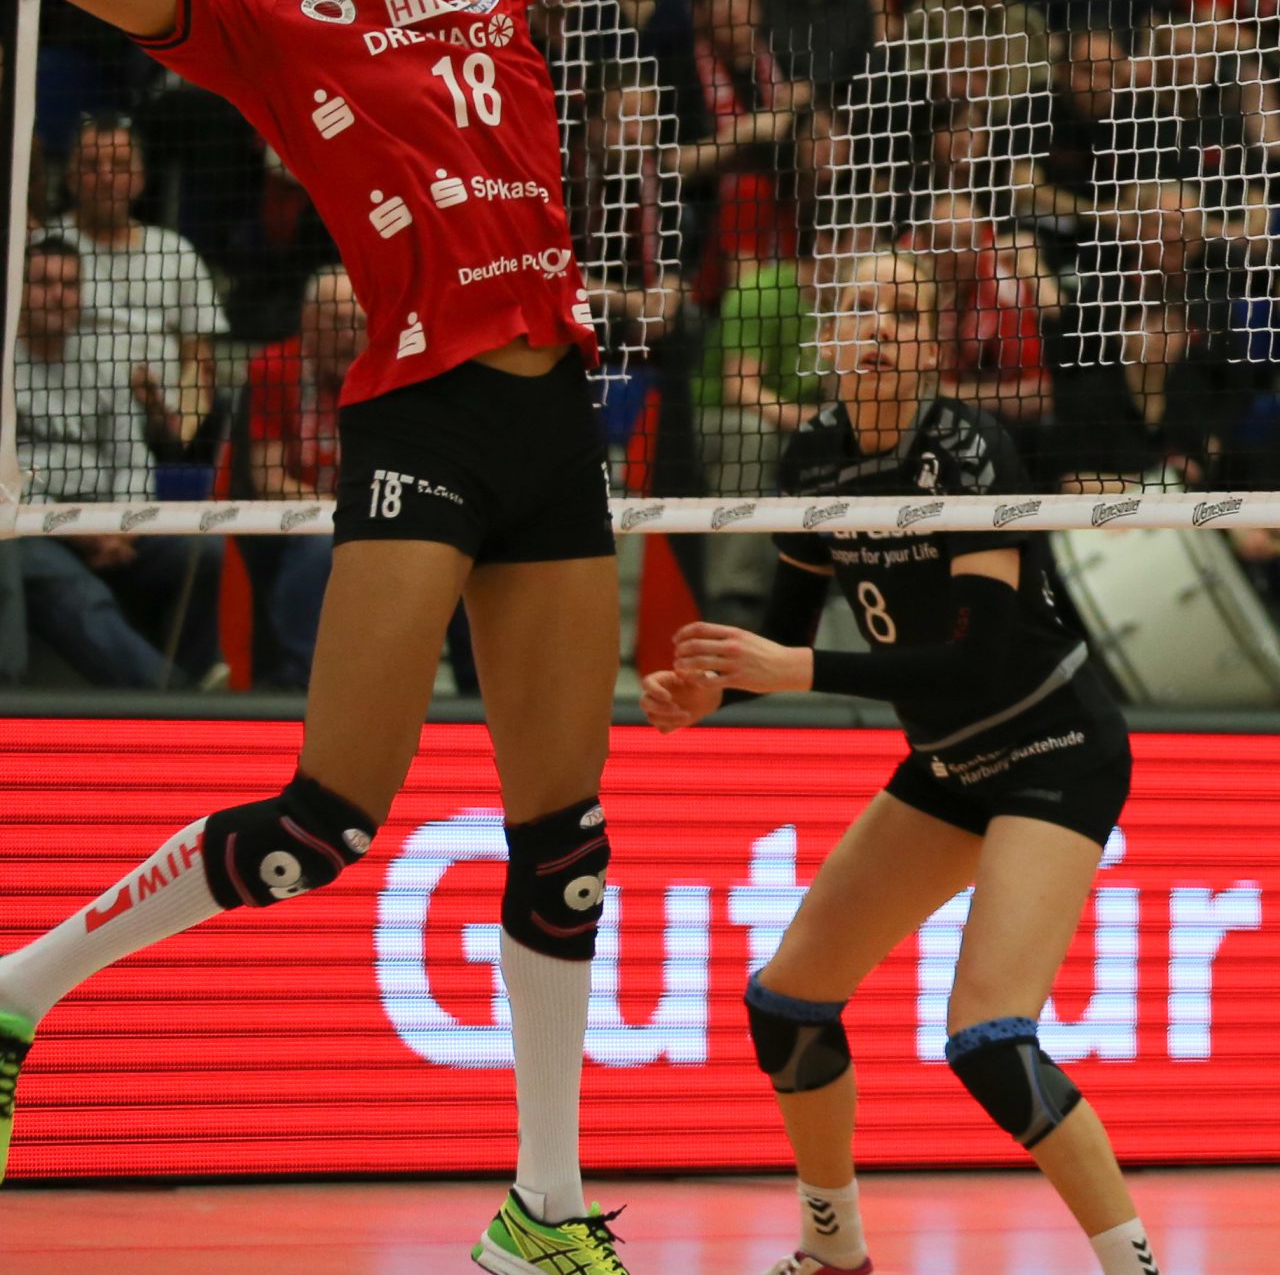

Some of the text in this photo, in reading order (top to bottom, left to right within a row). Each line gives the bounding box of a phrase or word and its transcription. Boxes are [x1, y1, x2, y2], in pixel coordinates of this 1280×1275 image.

[431, 51, 502, 129] 18
[369, 479, 402, 519] 18
[912, 544, 939, 562] Life
[858, 581, 897, 644] 8
